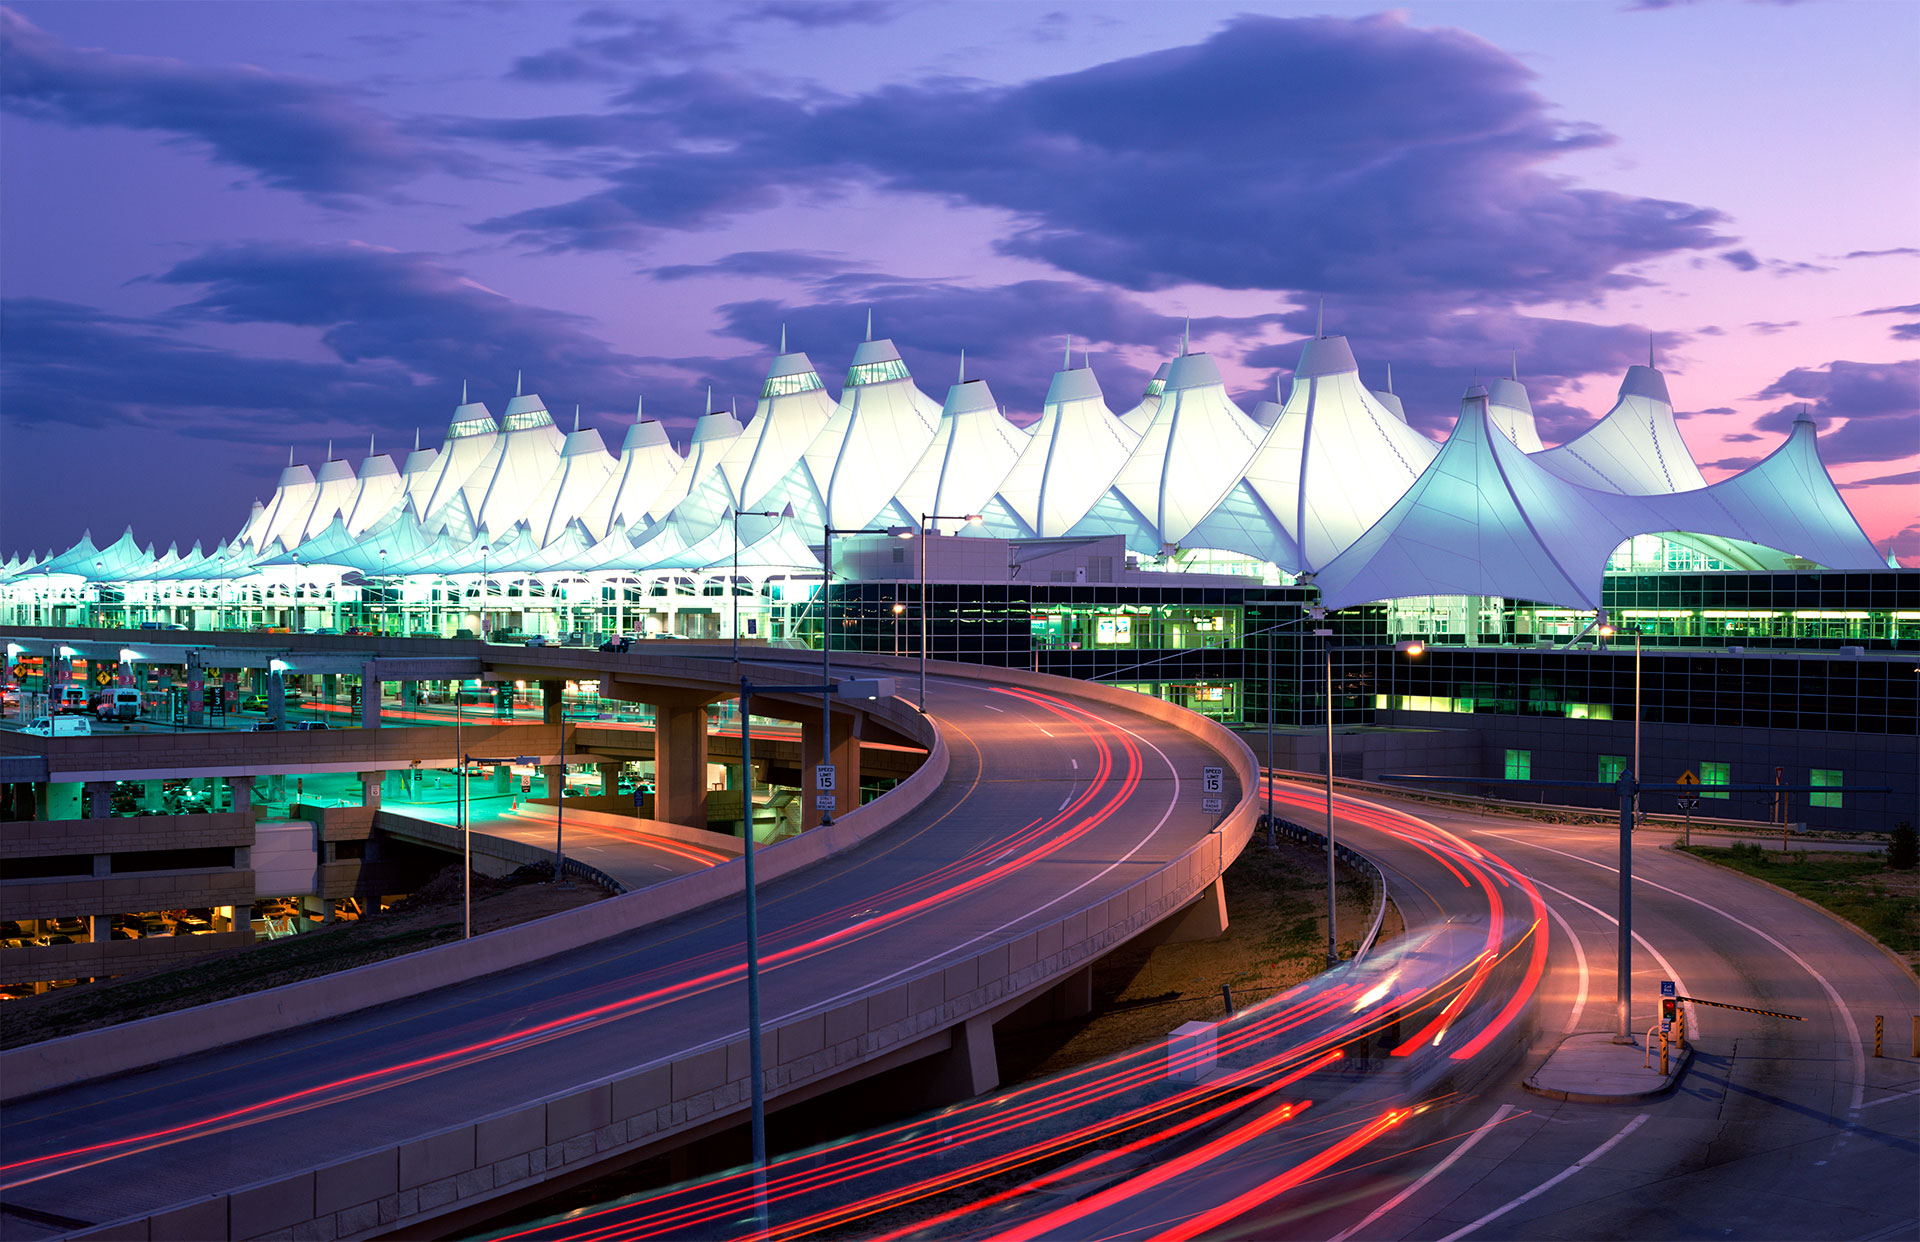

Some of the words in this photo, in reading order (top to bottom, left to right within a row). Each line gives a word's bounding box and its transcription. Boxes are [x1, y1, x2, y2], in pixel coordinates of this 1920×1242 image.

[215, 697, 220, 705] 3
[356, 696, 361, 704] 2
[820, 778, 832, 787] 15
[1207, 780, 1219, 790] 15
